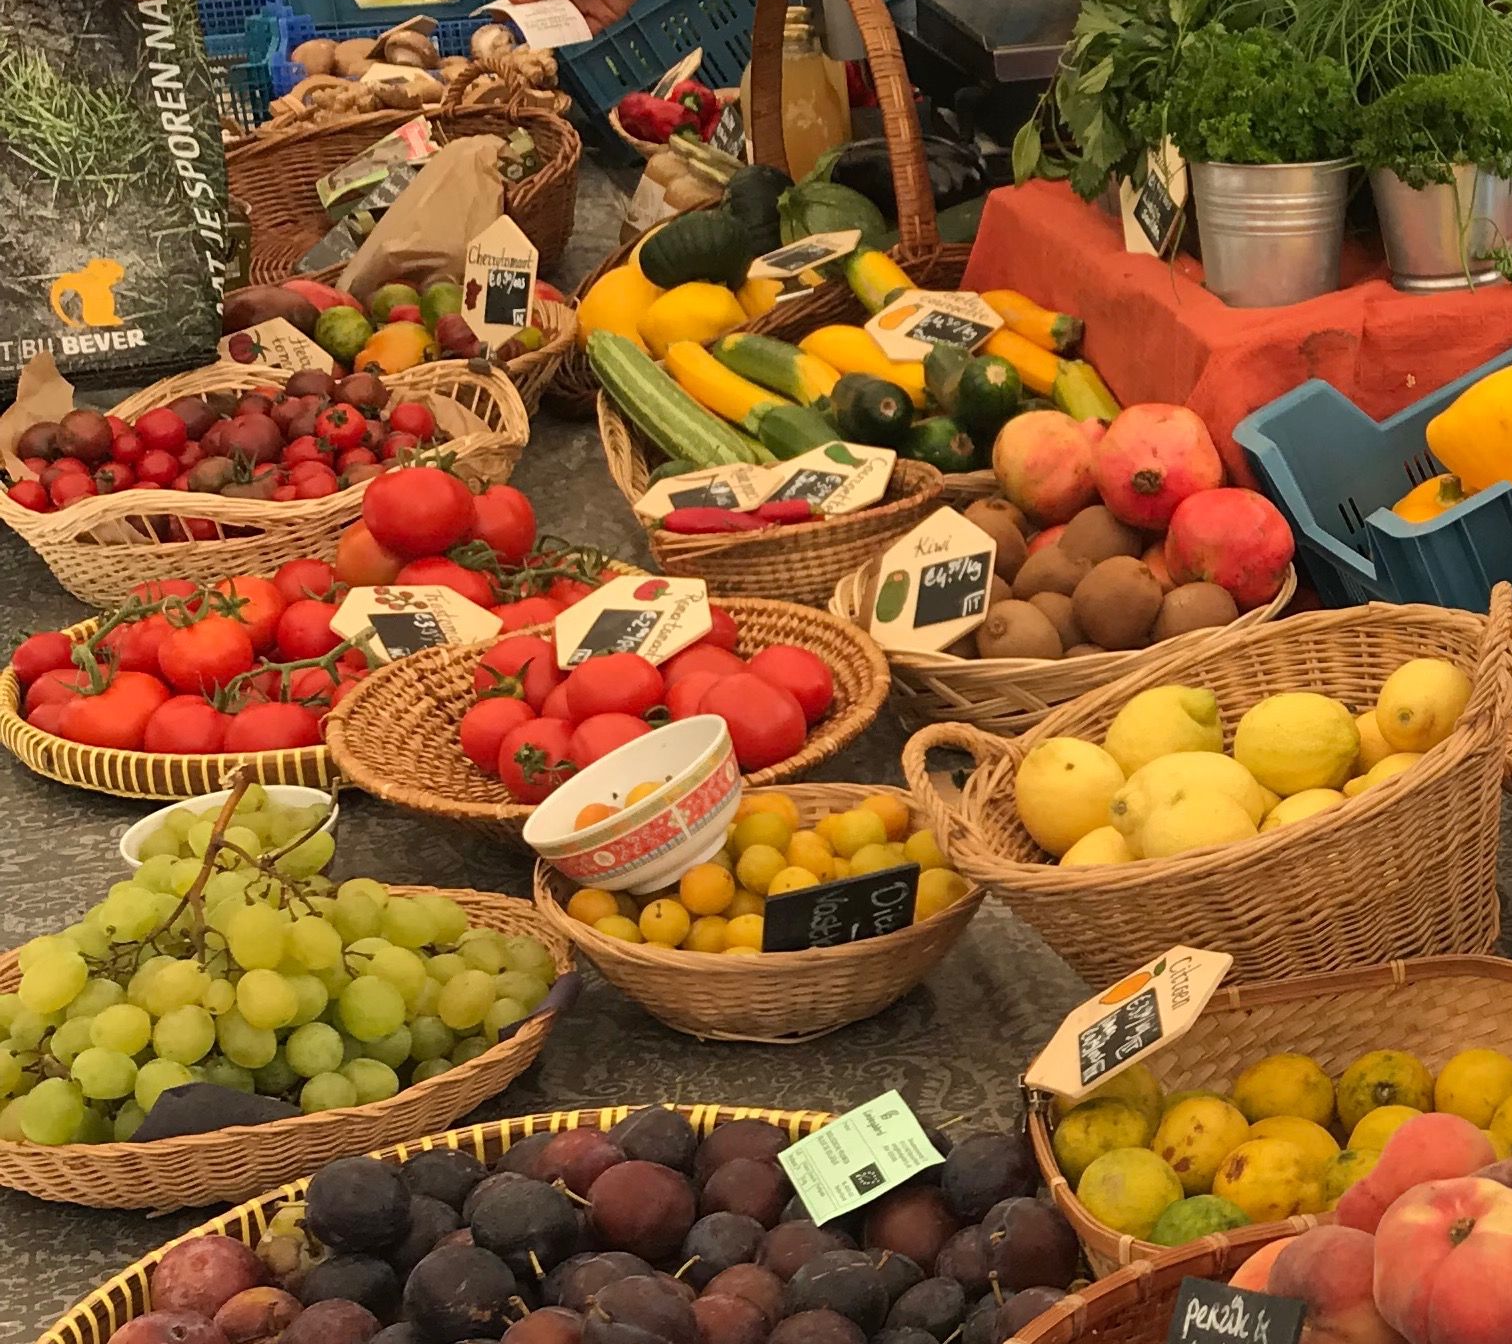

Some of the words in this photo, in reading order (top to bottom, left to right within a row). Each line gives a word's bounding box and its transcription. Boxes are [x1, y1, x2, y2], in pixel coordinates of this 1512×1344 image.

[149, 62, 217, 201] SPOREN
[195, 206, 224, 248] JE
[61, 328, 150, 355] BEVER
[914, 534, 953, 558] Kiwi
